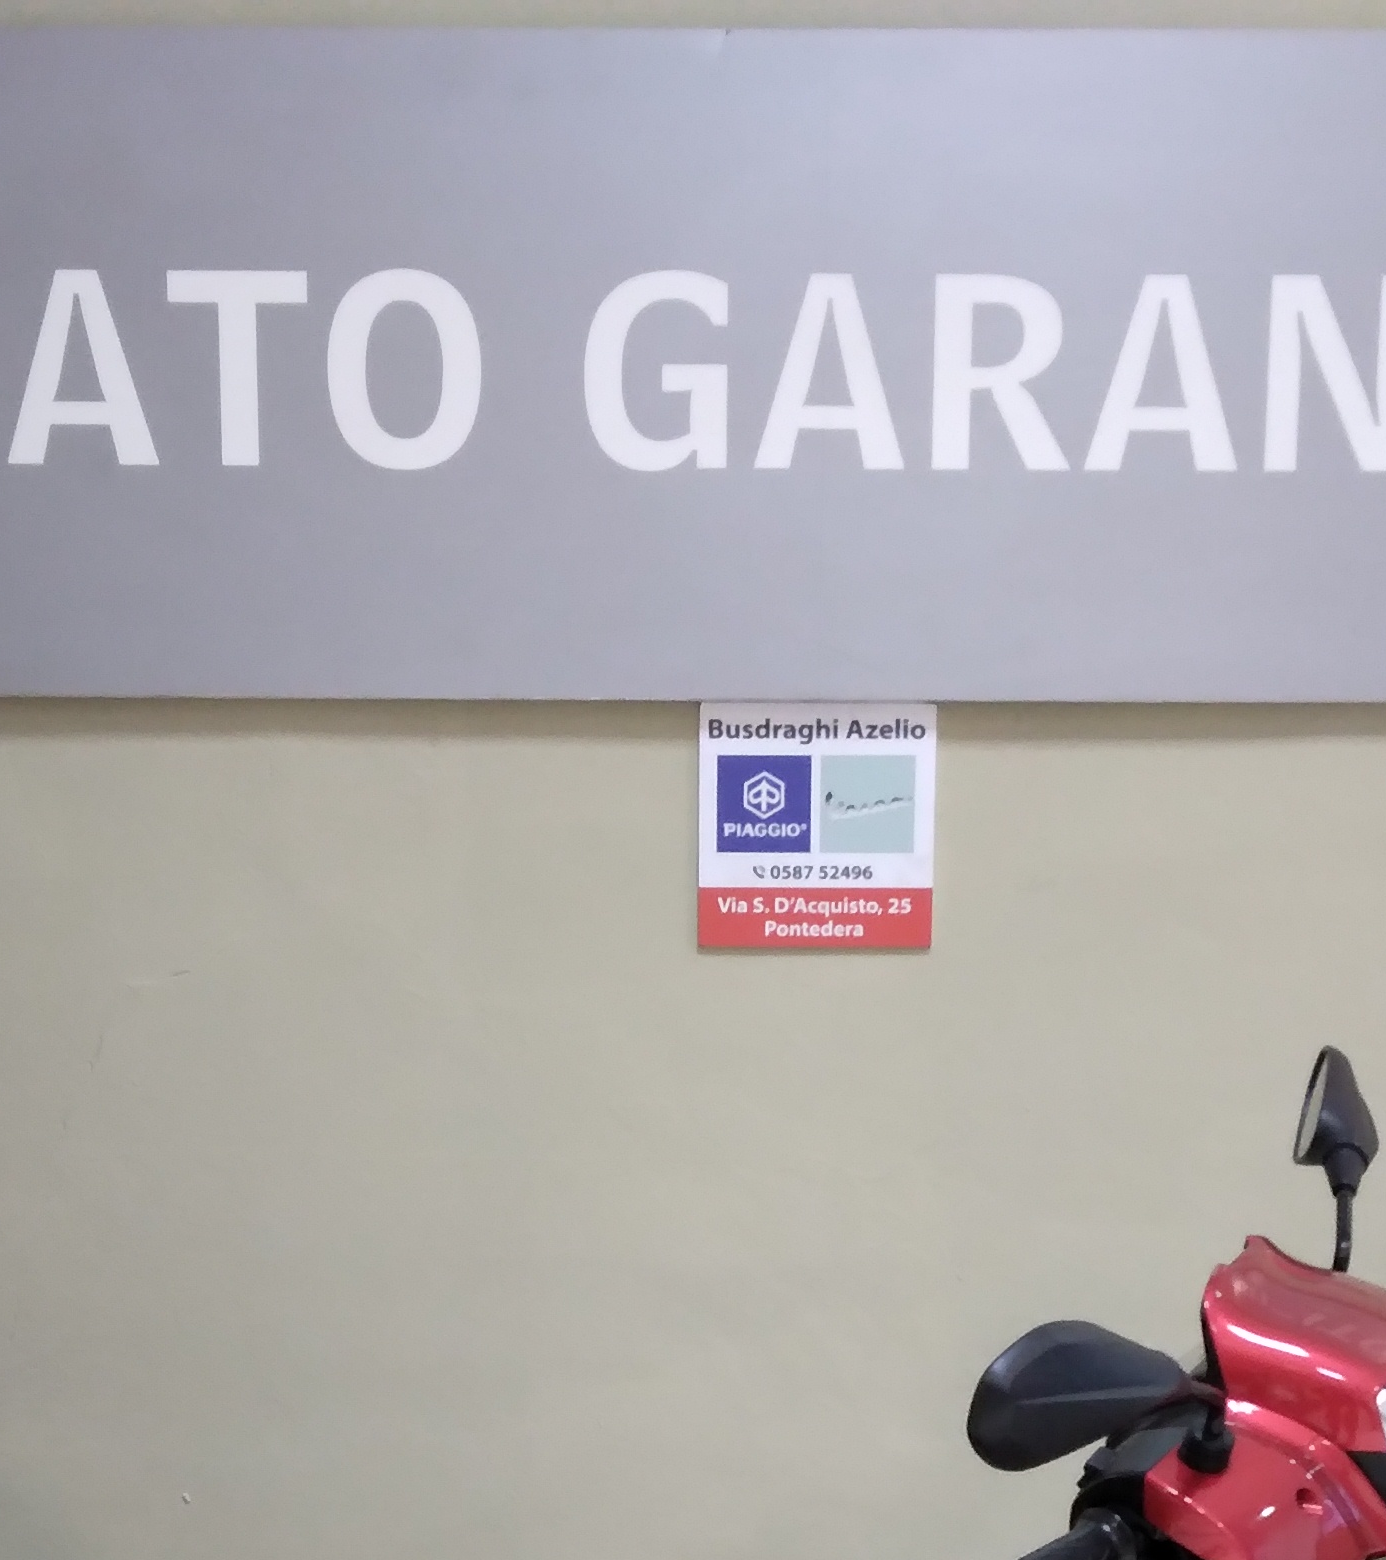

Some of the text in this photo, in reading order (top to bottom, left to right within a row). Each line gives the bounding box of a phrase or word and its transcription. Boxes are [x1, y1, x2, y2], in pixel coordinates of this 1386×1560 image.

[708, 718, 926, 745] Busdraghi Azelio
[723, 822, 801, 838] PIAGGIO
[769, 865, 873, 880] 0587 52496
[717, 896, 748, 914] Via
[752, 896, 770, 914] S.
[887, 897, 912, 914] 25
[764, 920, 864, 937] Pontedera
